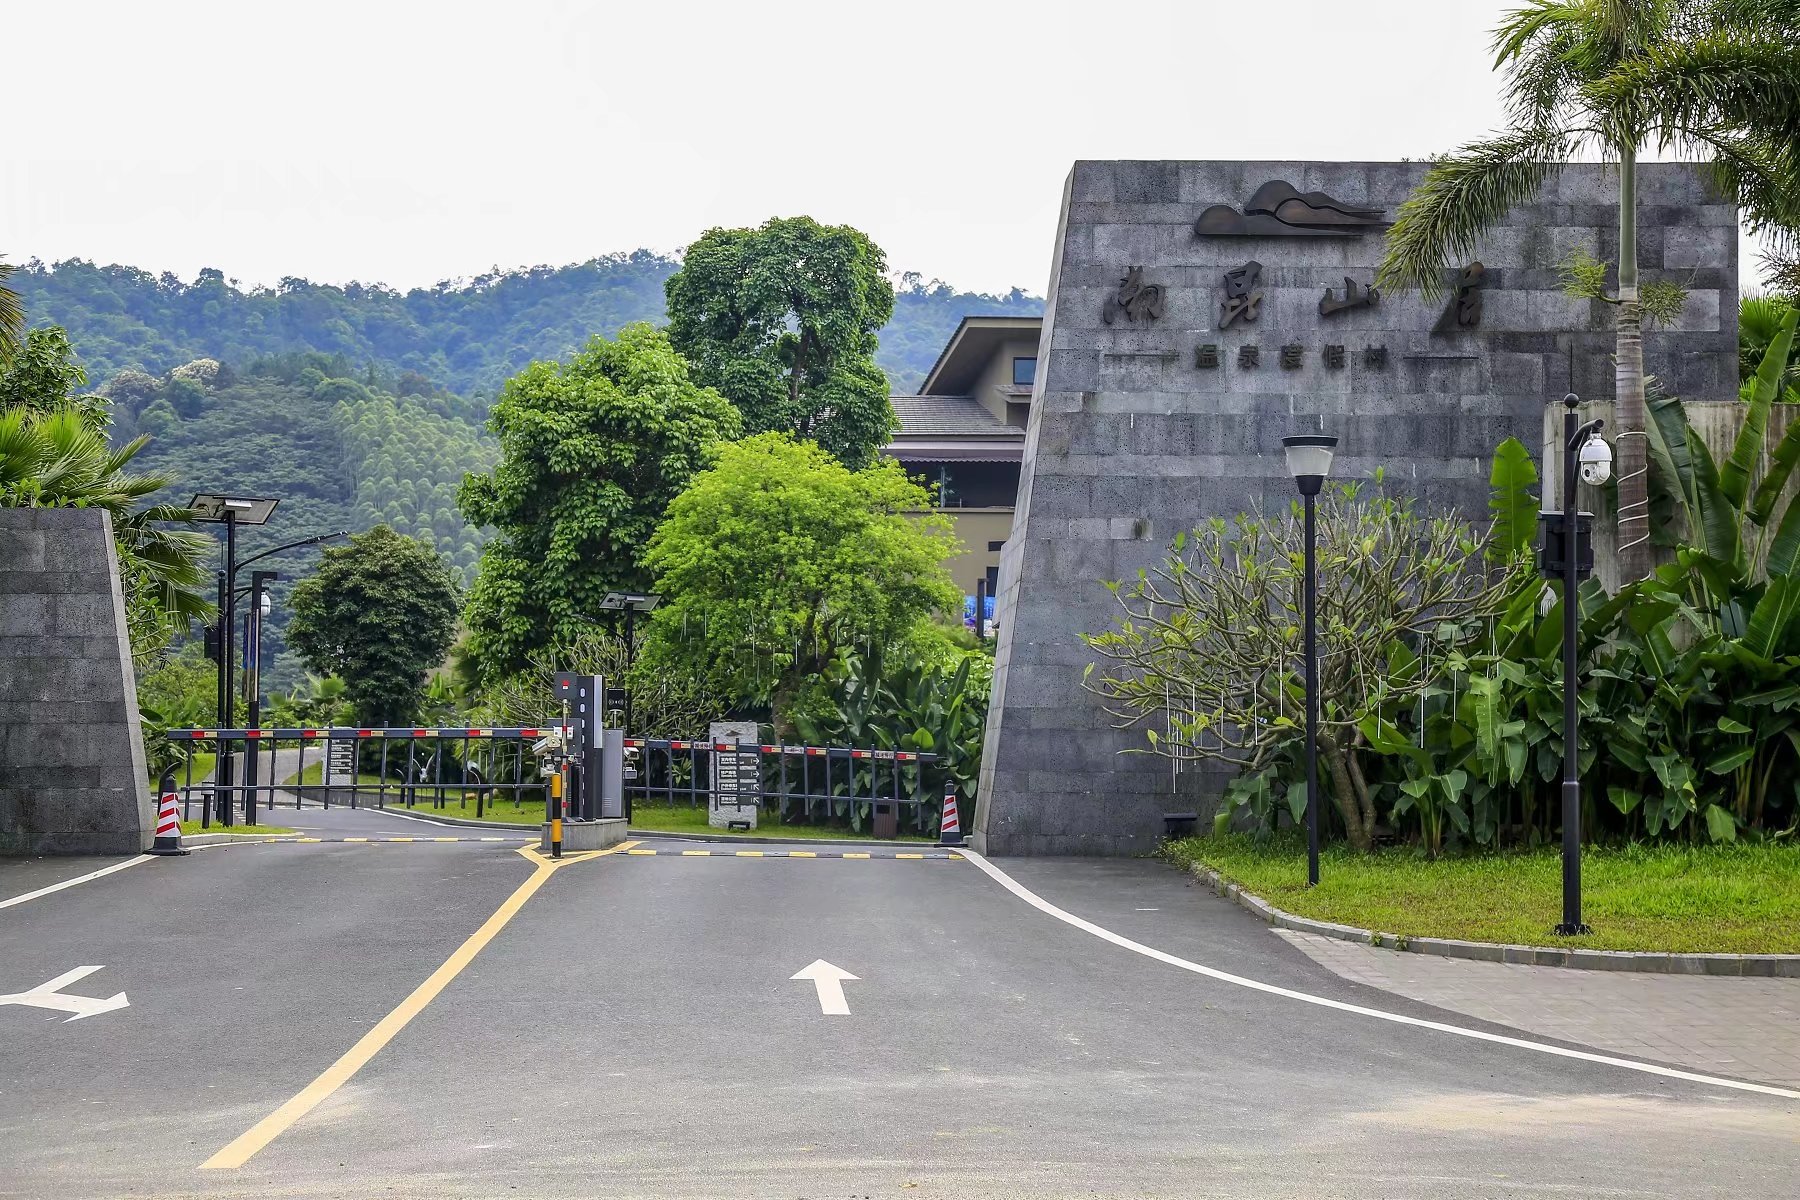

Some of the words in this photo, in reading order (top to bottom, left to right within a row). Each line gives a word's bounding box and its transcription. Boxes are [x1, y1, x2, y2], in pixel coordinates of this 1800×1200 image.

[1103, 260, 1485, 337] 南昆山居
[1195, 343, 1389, 370] 温泉度假村
